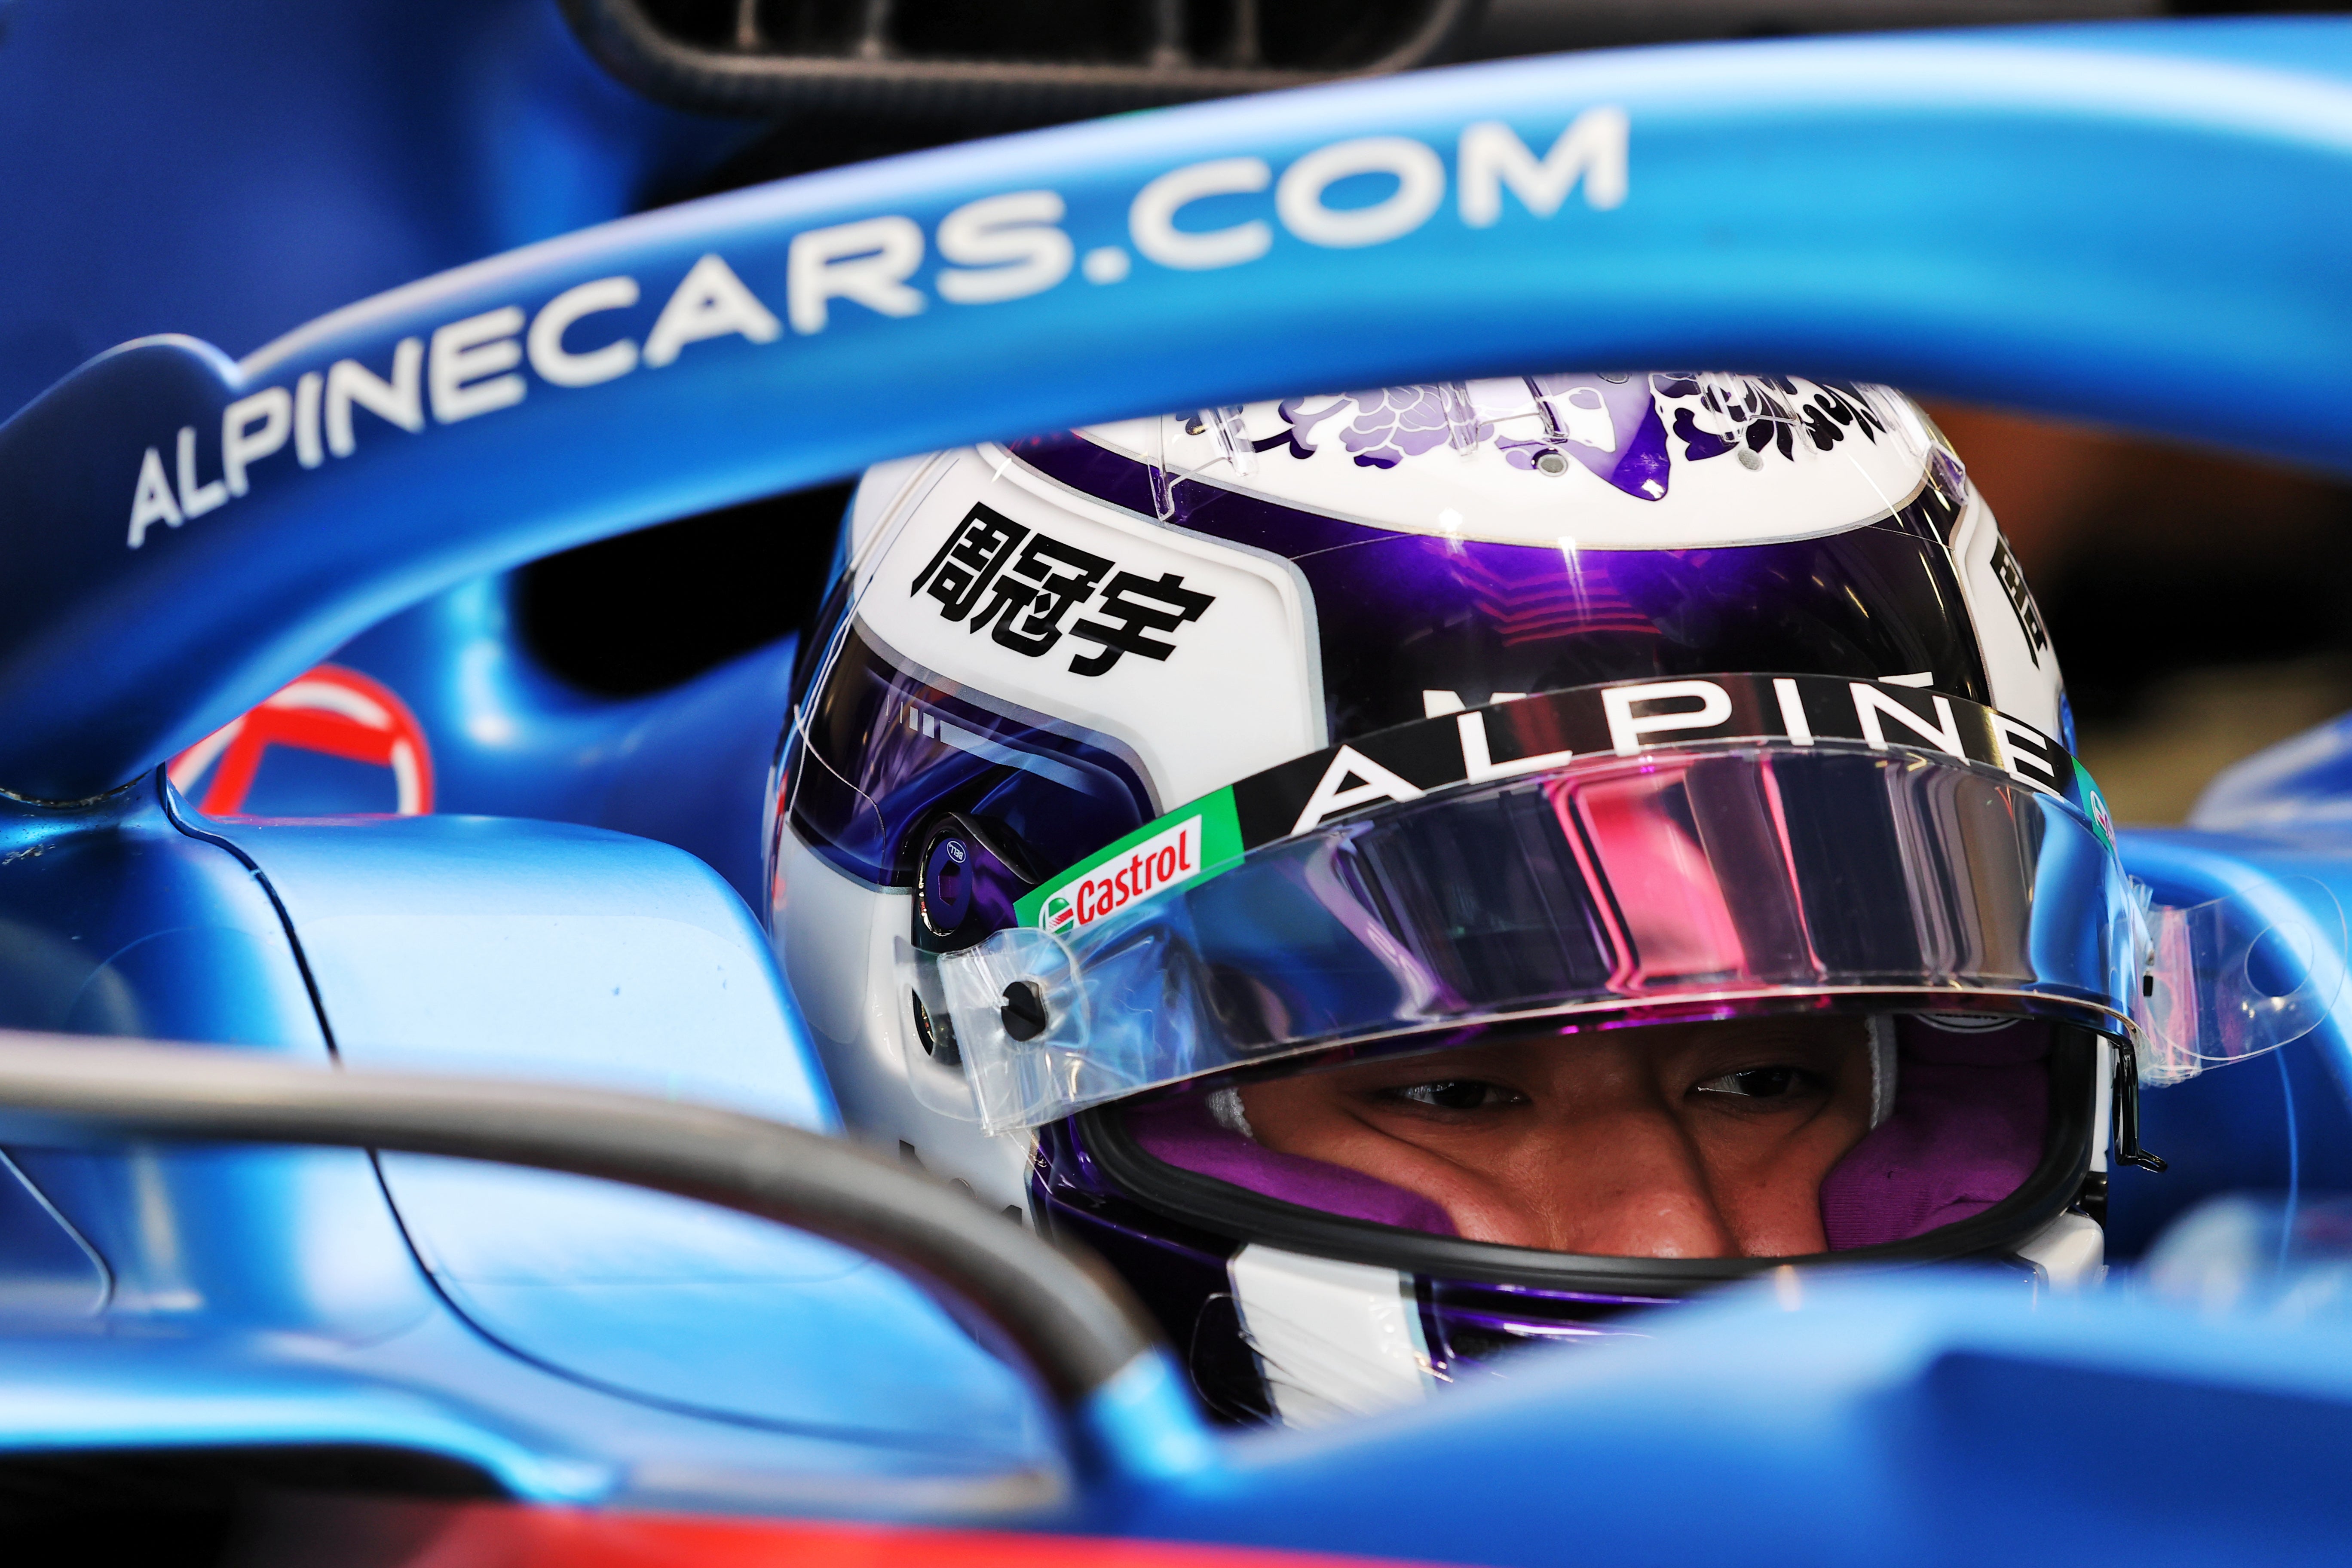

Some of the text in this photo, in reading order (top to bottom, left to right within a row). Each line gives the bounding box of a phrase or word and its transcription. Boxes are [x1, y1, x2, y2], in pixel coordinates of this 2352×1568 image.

[127, 105, 1629, 550] ALPINECARS.COM
[910, 502, 1216, 677] 周冠宇
[1291, 679, 2064, 836] ALPINE
[1077, 830, 1191, 925] Castrol
